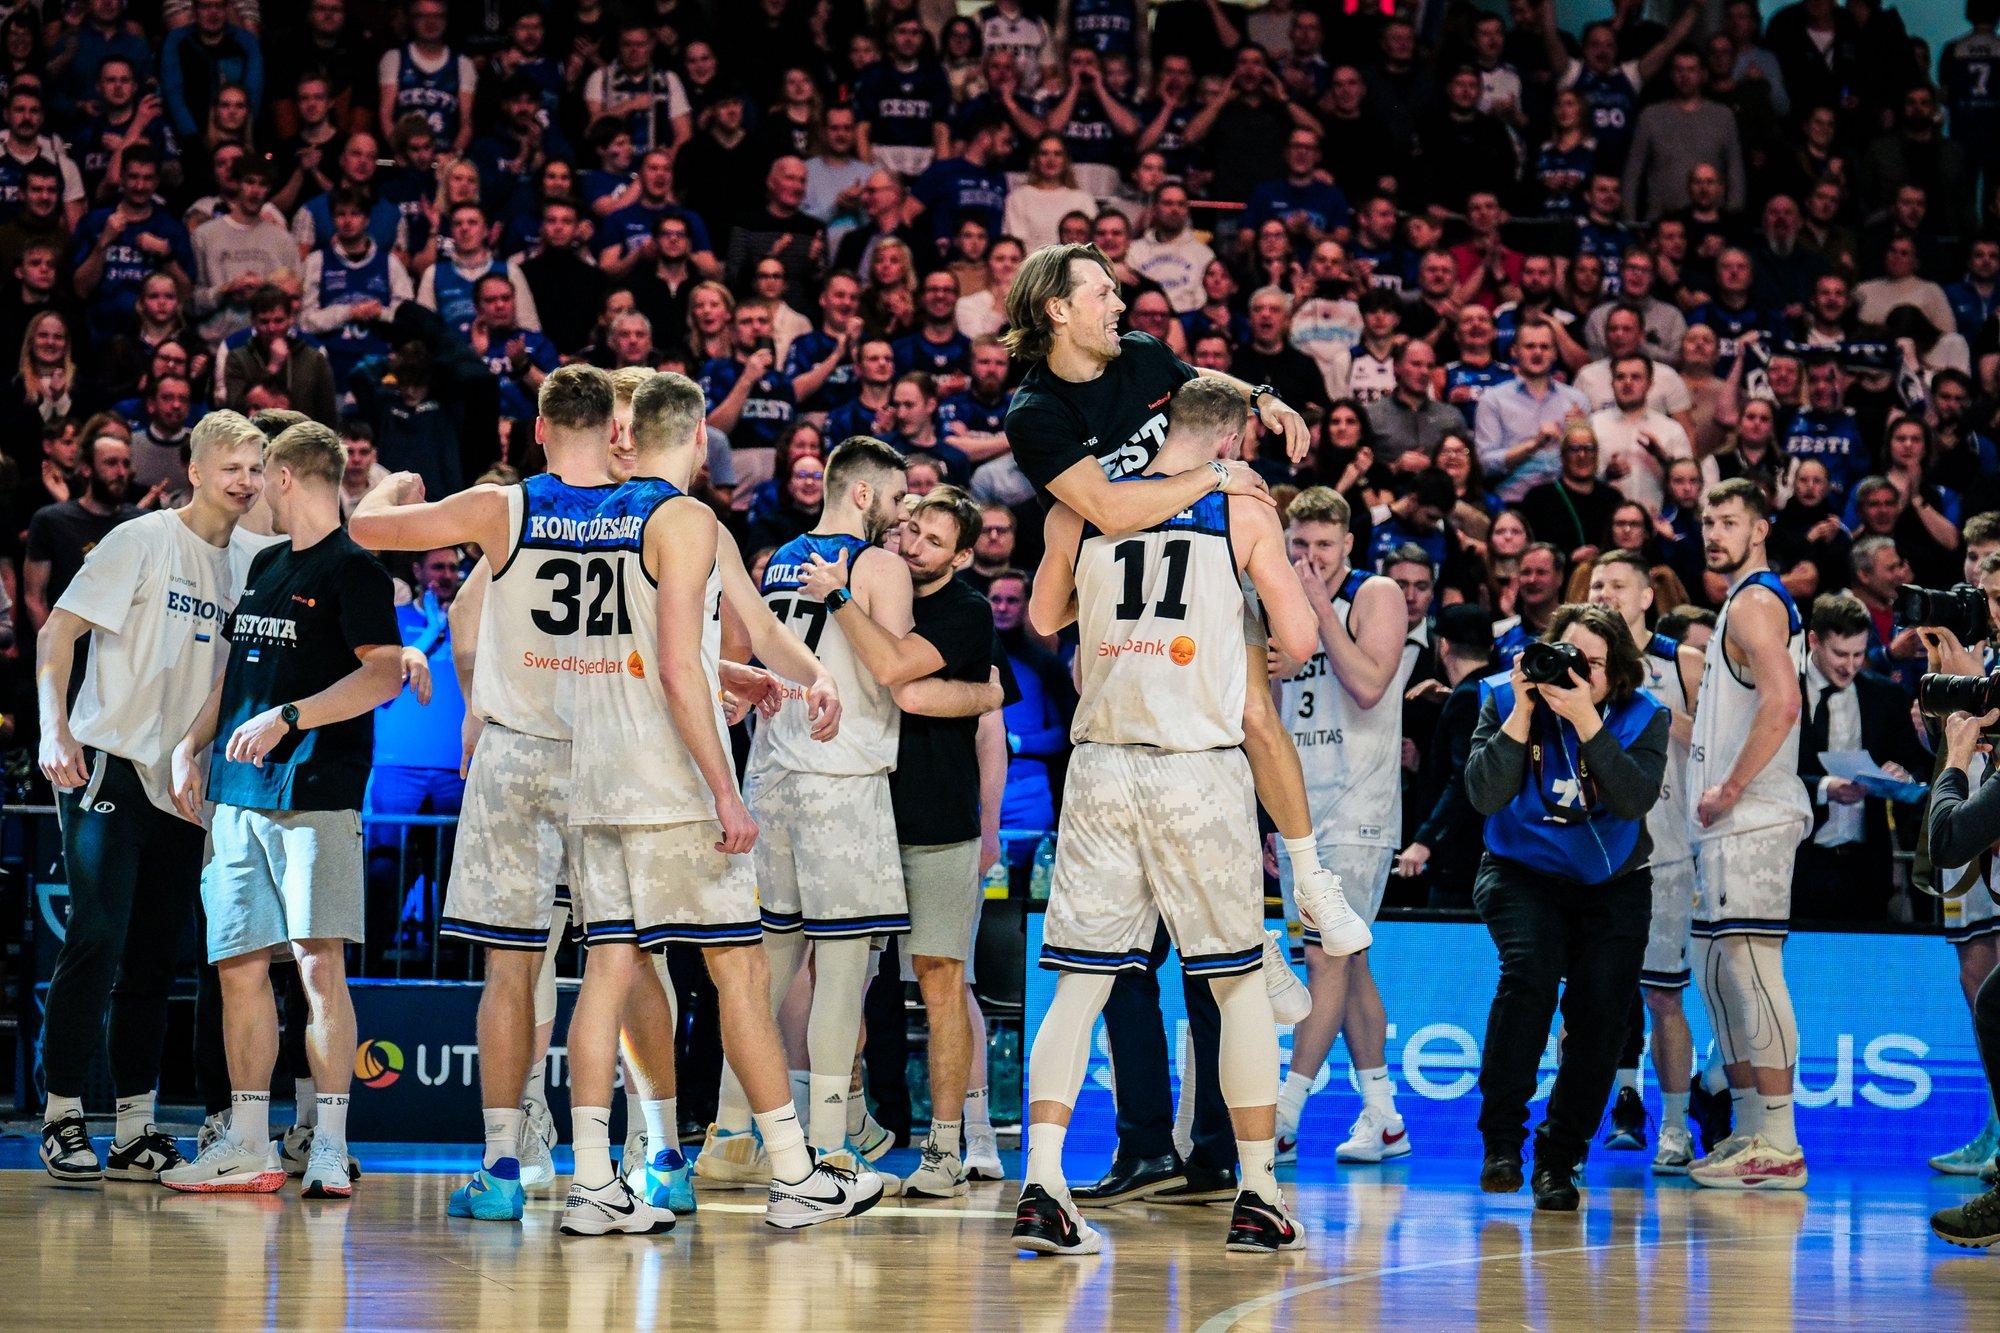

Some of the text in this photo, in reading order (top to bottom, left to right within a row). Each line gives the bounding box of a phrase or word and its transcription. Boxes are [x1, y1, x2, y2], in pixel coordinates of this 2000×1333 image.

[1966, 61, 1991, 97] 7
[1114, 539, 1191, 621] 11
[233, 613, 298, 641] ESTONA
[1298, 691, 1315, 719] 3
